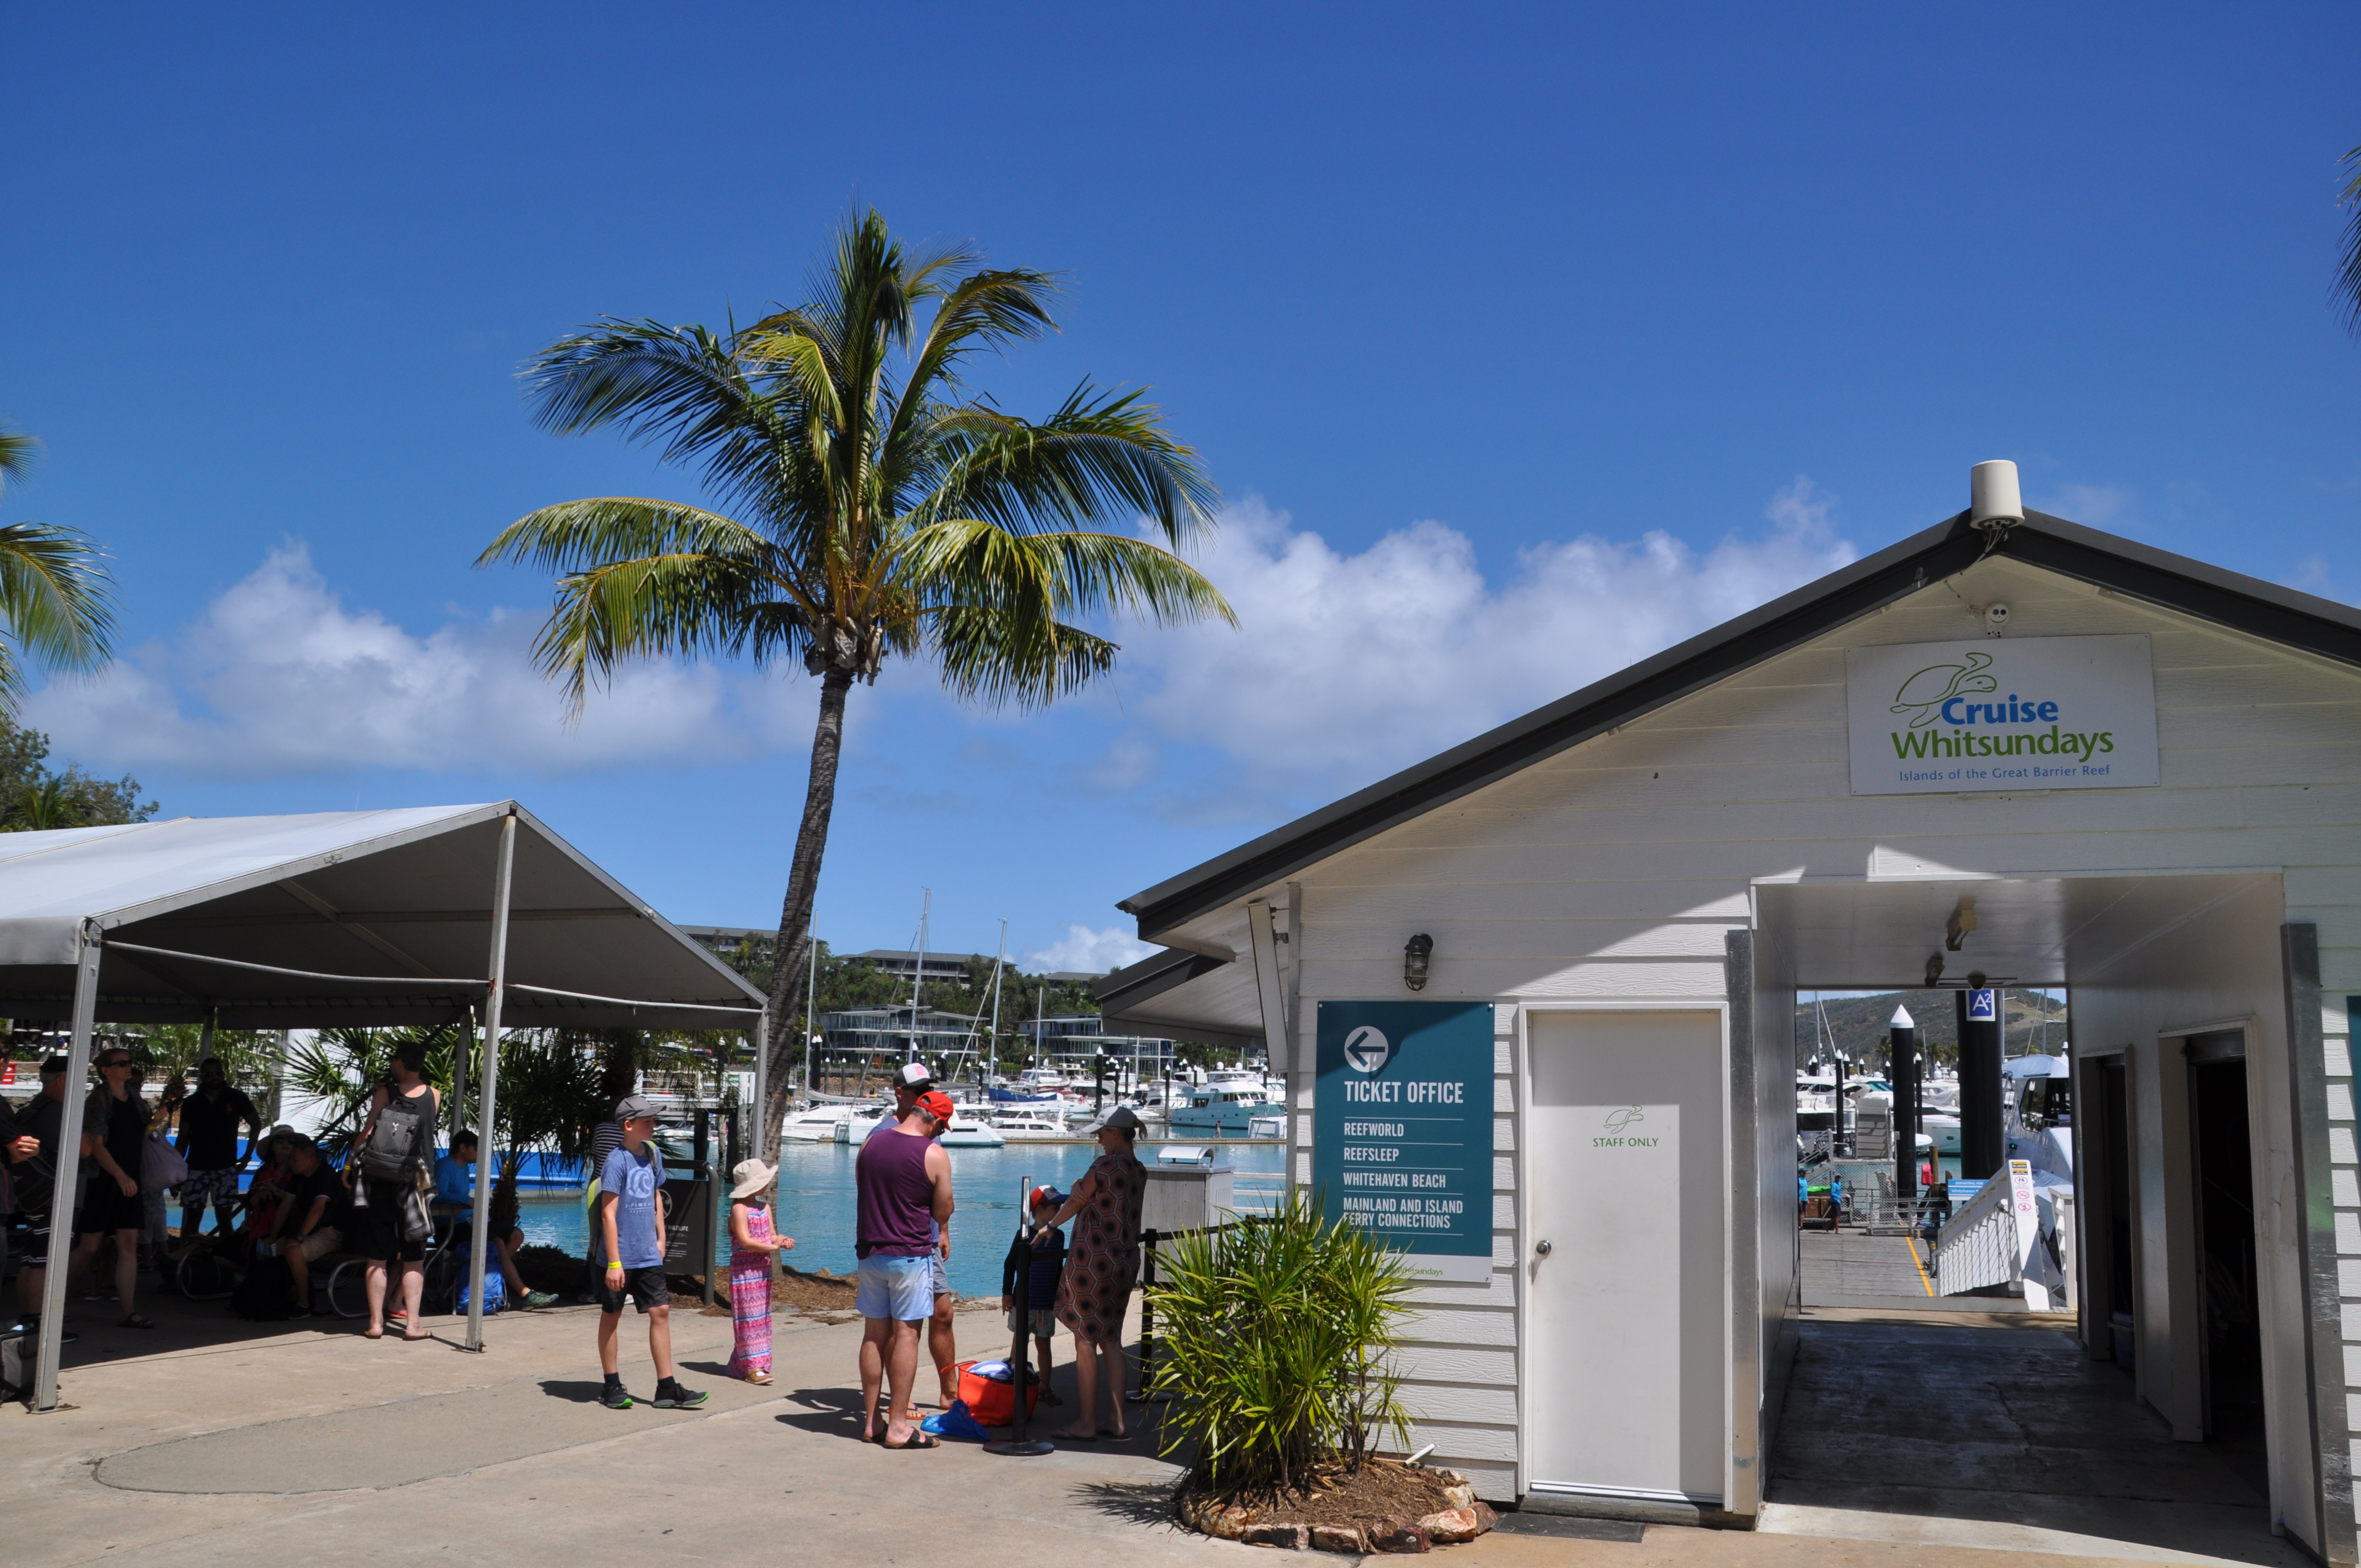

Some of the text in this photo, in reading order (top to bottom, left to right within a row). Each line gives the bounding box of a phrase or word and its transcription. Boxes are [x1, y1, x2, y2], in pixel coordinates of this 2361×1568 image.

[1941, 694, 2059, 725] Cruise
[1891, 725, 2114, 763] Whitsundays
[1900, 764, 2111, 781] Islands of the Great Barrier Reef
[1344, 1080, 1464, 1104] TICKET OFFICE
[1344, 1122, 1404, 1137] REEFWORLD
[1593, 1137, 1659, 1147] STAFF ONLY
[1343, 1146, 1399, 1162] REEFSLEEP
[1343, 1172, 1446, 1188] WHITEHAVEN BEACH
[1343, 1197, 1463, 1214] MAINLAND AND ISLAND
[1343, 1212, 1451, 1229] FERRY CONNECTIONS
